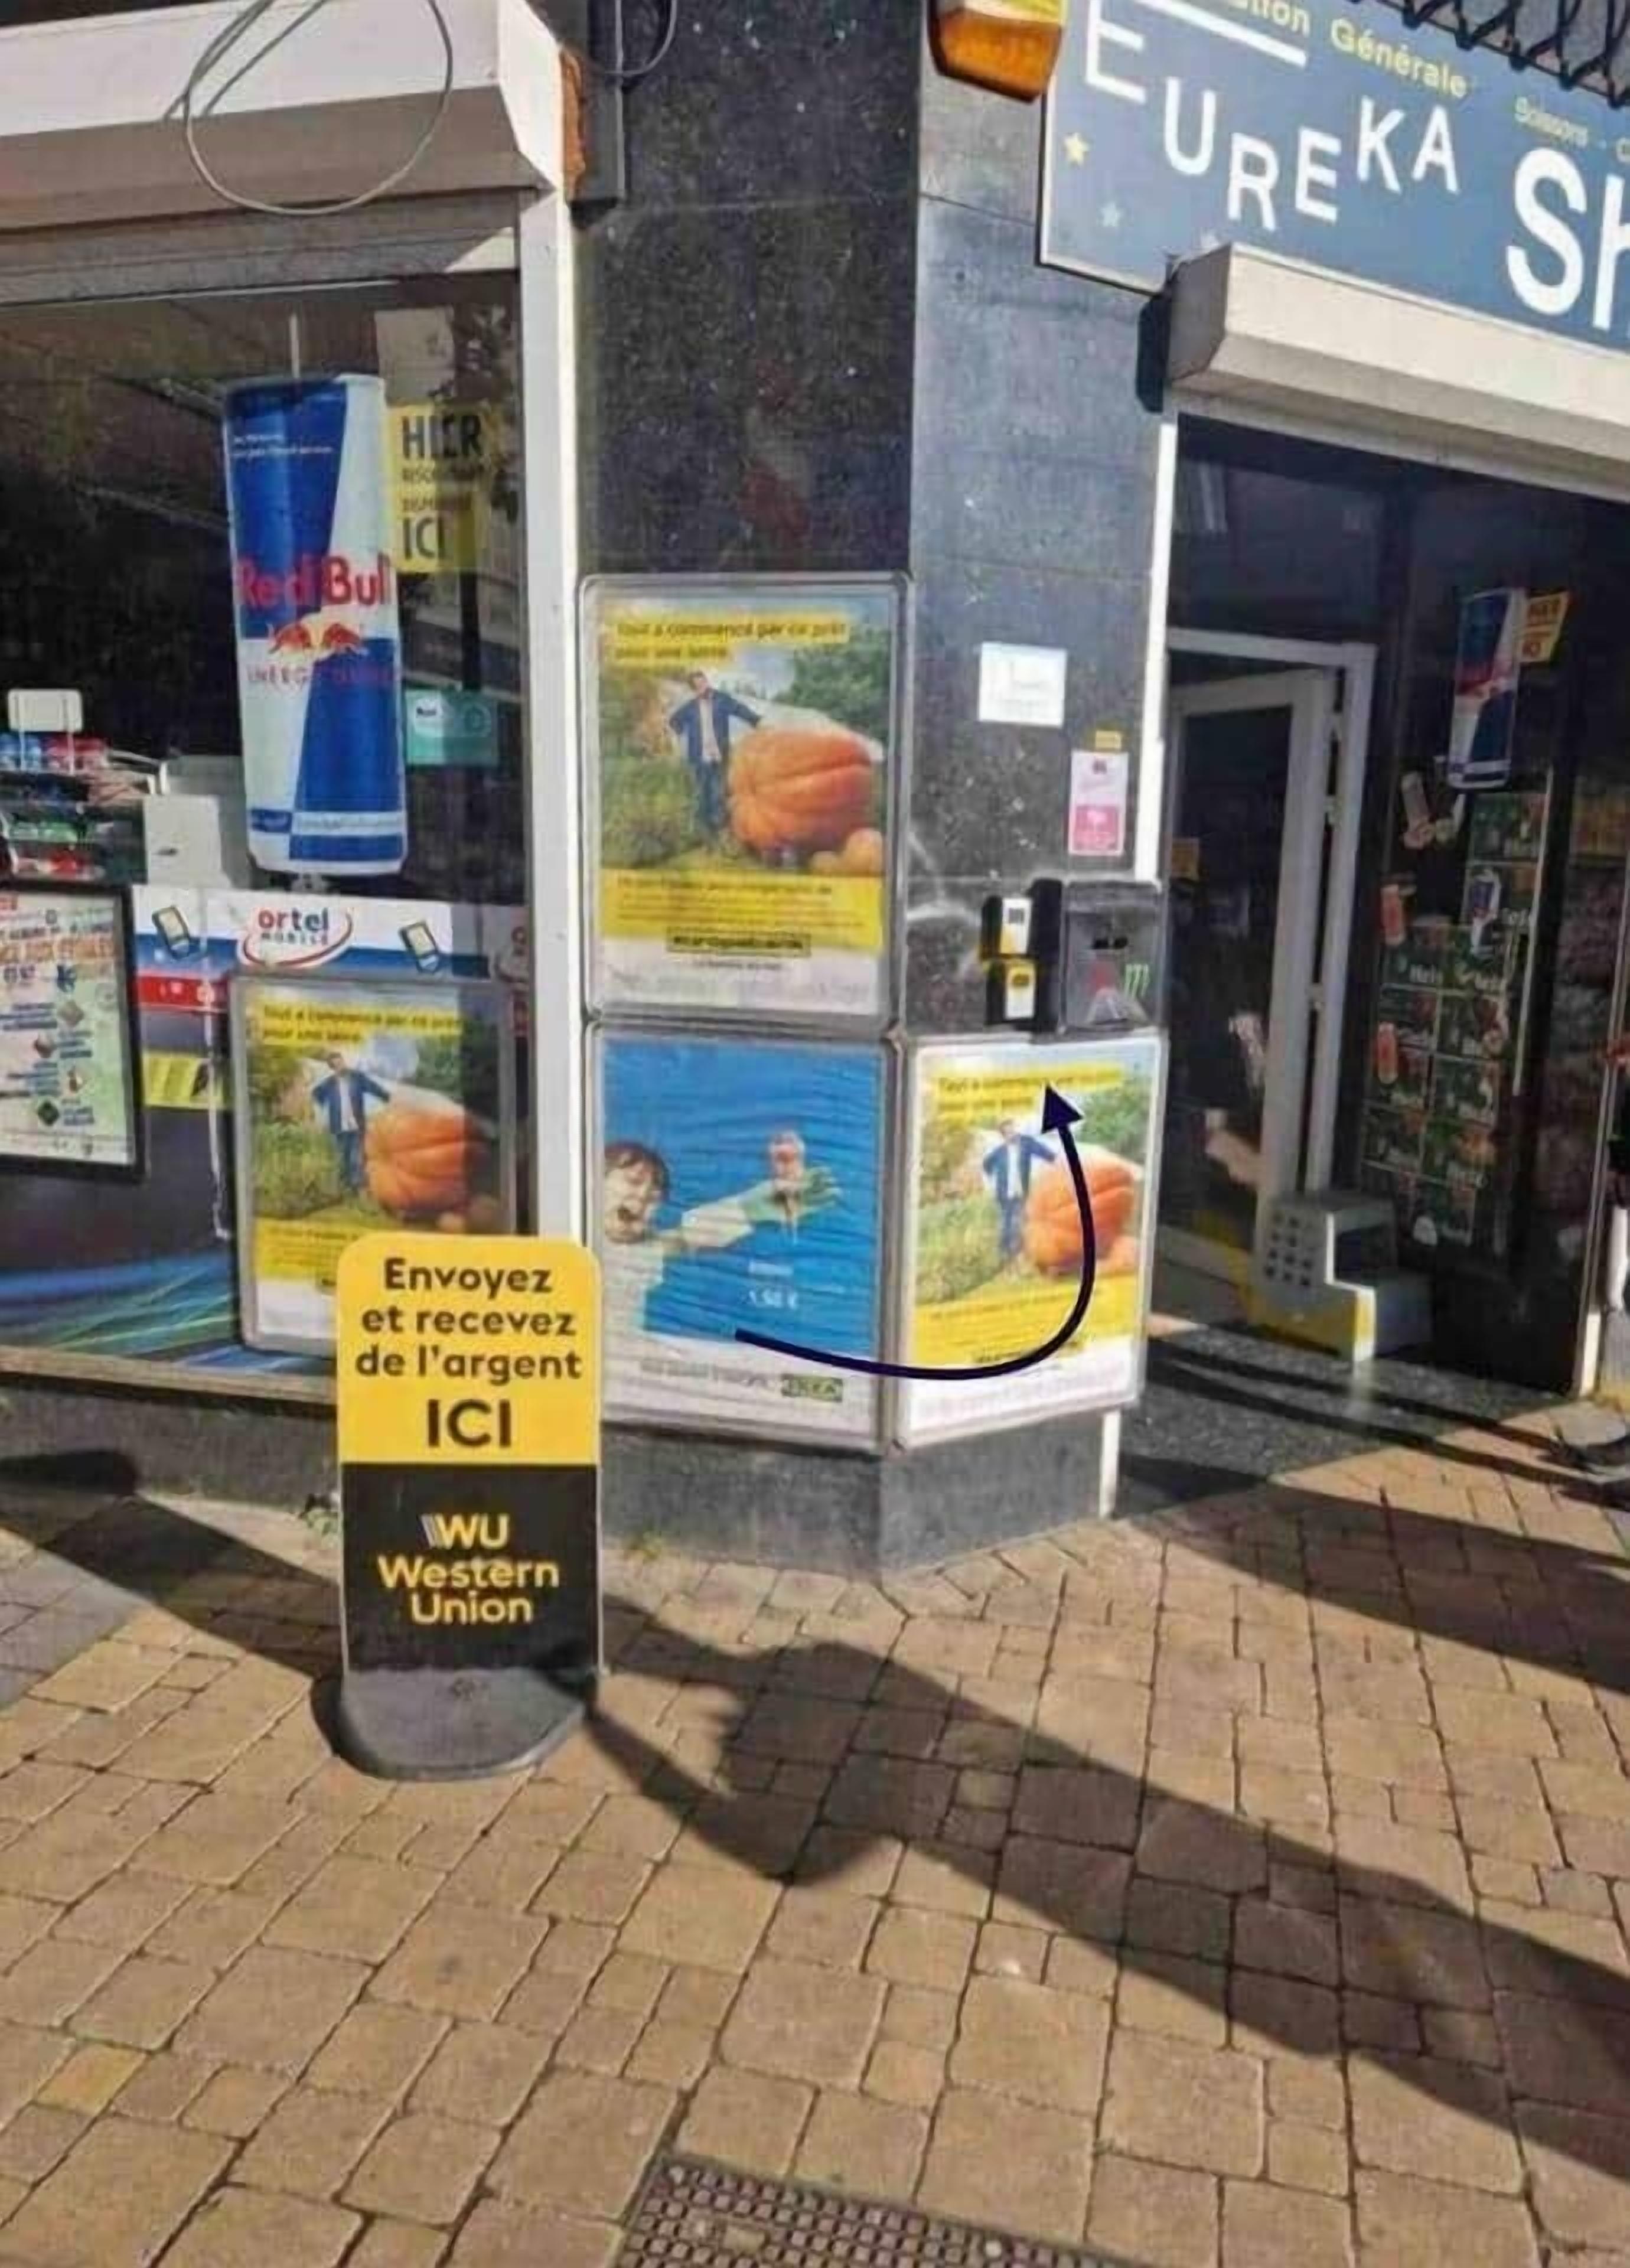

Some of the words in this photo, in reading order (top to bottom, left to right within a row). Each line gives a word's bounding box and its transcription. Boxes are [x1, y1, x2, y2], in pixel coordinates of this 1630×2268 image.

[1331, 18, 1468, 98] Générale
[1084, 0, 1460, 233] EUREKA
[402, 415, 484, 457] HIER
[402, 516, 447, 560] ICI
[238, 554, 315, 606] Red
[258, 907, 329, 931] ortel
[384, 1256, 553, 1299] Envoyez
[361, 1308, 403, 1334] et
[416, 1309, 577, 1337] recevez
[356, 1343, 405, 1378] de
[418, 1344, 582, 1386] l'argent
[427, 1398, 513, 1448] ICI
[421, 1513, 509, 1549] WU
[377, 1555, 560, 1589] Western
[411, 1590, 534, 1625] Union
